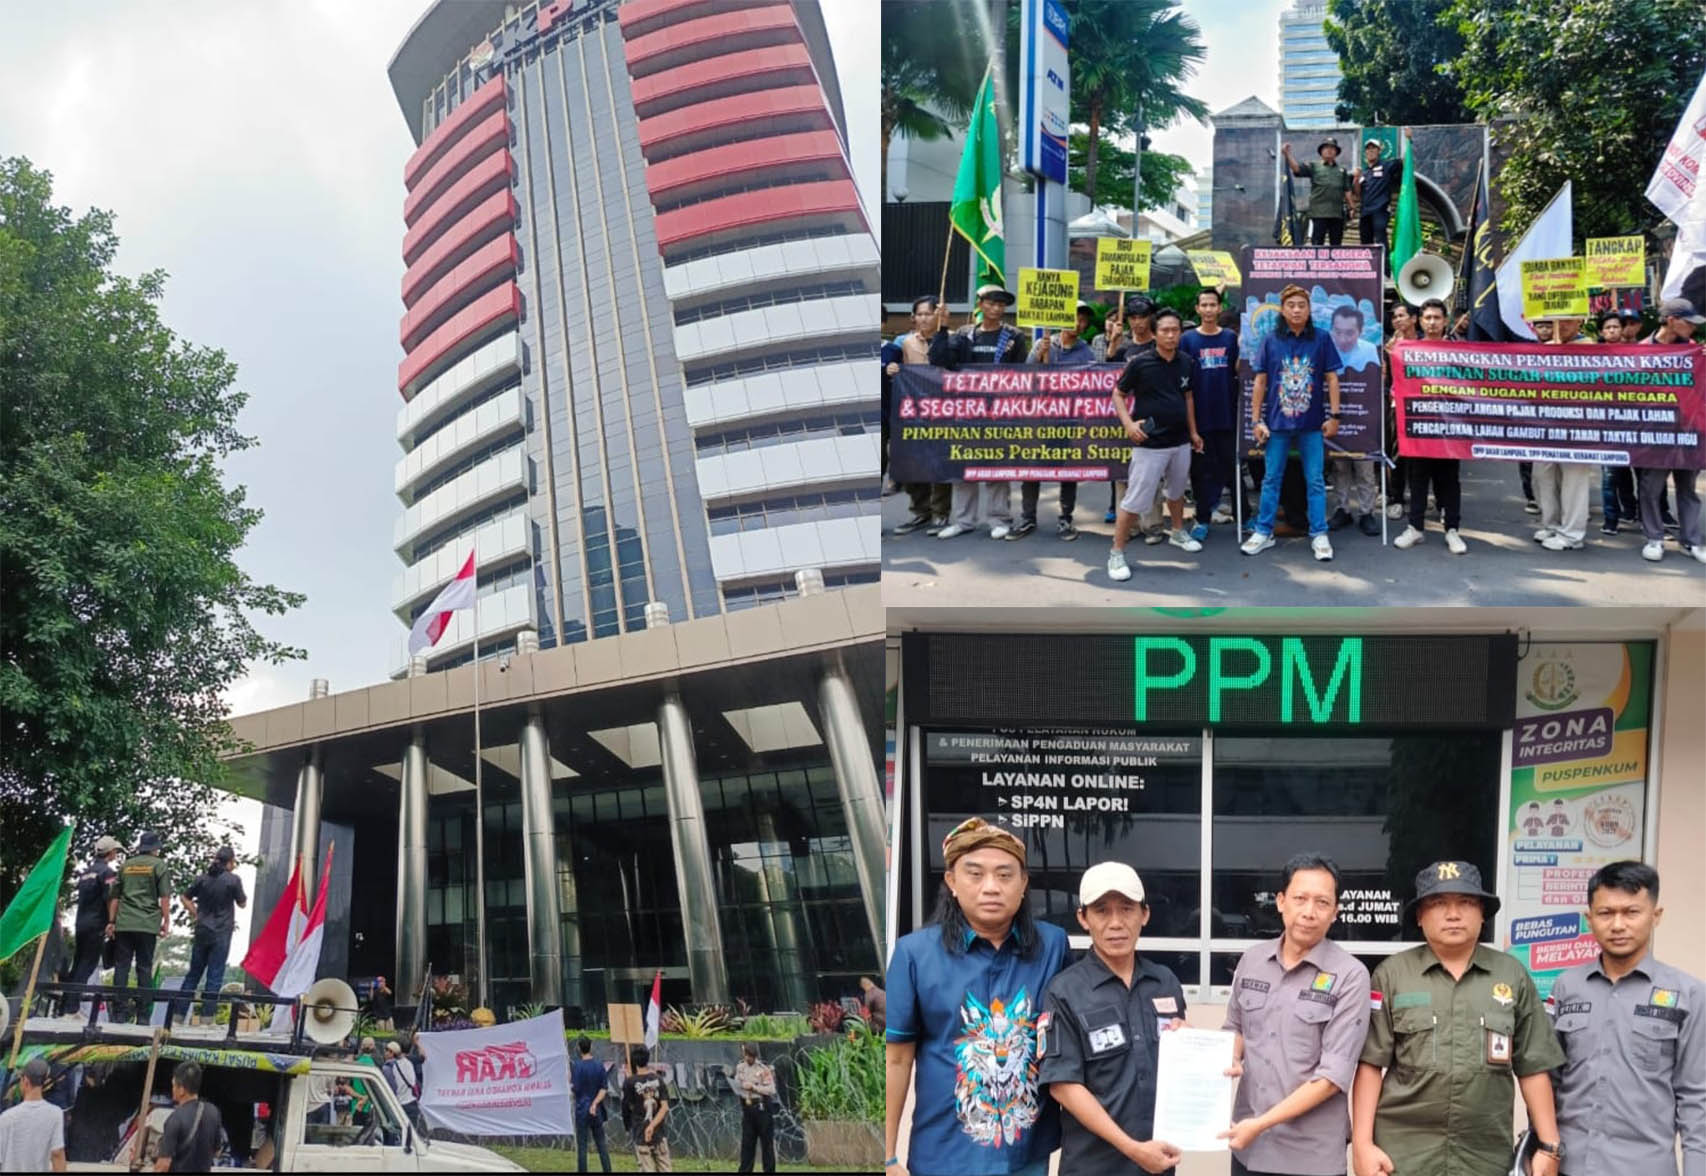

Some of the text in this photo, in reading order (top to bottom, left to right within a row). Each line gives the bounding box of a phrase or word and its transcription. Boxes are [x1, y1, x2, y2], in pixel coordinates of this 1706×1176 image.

[1588, 237, 1641, 255] TANGKAP
[1026, 281, 1074, 298] KEJAGUNG
[1404, 350, 1693, 369] KEMBANGKAN PEMERIKSAAN KASUS
[944, 372, 1032, 391] TETAPKAN
[1405, 365, 1694, 386] PIMPINAN SUGAR GROUP COMPANIE
[1421, 385, 1677, 403] DENGAN DUGAAN KERUGIAN NEGARA
[900, 400, 915, 417] &
[920, 399, 986, 417] SEGERA
[1074, 398, 1134, 417] PENA
[1506, 405, 1536, 418] PAJAK
[1538, 406, 1583, 419] PRODUKSI
[1586, 408, 1604, 419] DAN
[1607, 408, 1639, 421] PAJAK
[1642, 409, 1675, 422] LAHAN
[902, 427, 981, 440] PIMPINAN
[984, 426, 1032, 439] SUGAR
[1037, 426, 1086, 439] GROUP
[1507, 427, 1545, 440] GAMBUT
[1548, 428, 1566, 440] DAN
[1640, 431, 1674, 444] DILUAR
[951, 445, 1134, 463] Kasus Perkara Suap
[1134, 637, 1363, 724] PPM
[1519, 714, 1607, 743] ZONA
[939, 738, 1190, 753] & PENERIMAAN PENGADUAN MASYARAKAT
[1518, 736, 1607, 758] INTEGRITAS
[971, 753, 1158, 767] PELAYANAN INFORMASI PUBLIK
[982, 772, 1145, 790] LAYANAN ONLINE:
[1541, 761, 1638, 784] PUSPENKUM
[1011, 795, 1129, 812] SP4N LAPOR!
[1516, 840, 1579, 851] PELAYANAN
[1338, 889, 1391, 900] AYANAN
[1357, 902, 1400, 912] JUMAT
[1340, 913, 1399, 924] 16.00 WIB
[1515, 919, 1553, 931] BEBAS
[1515, 925, 1577, 940] PUNGUTAN
[1536, 943, 1572, 954] BERSIH
